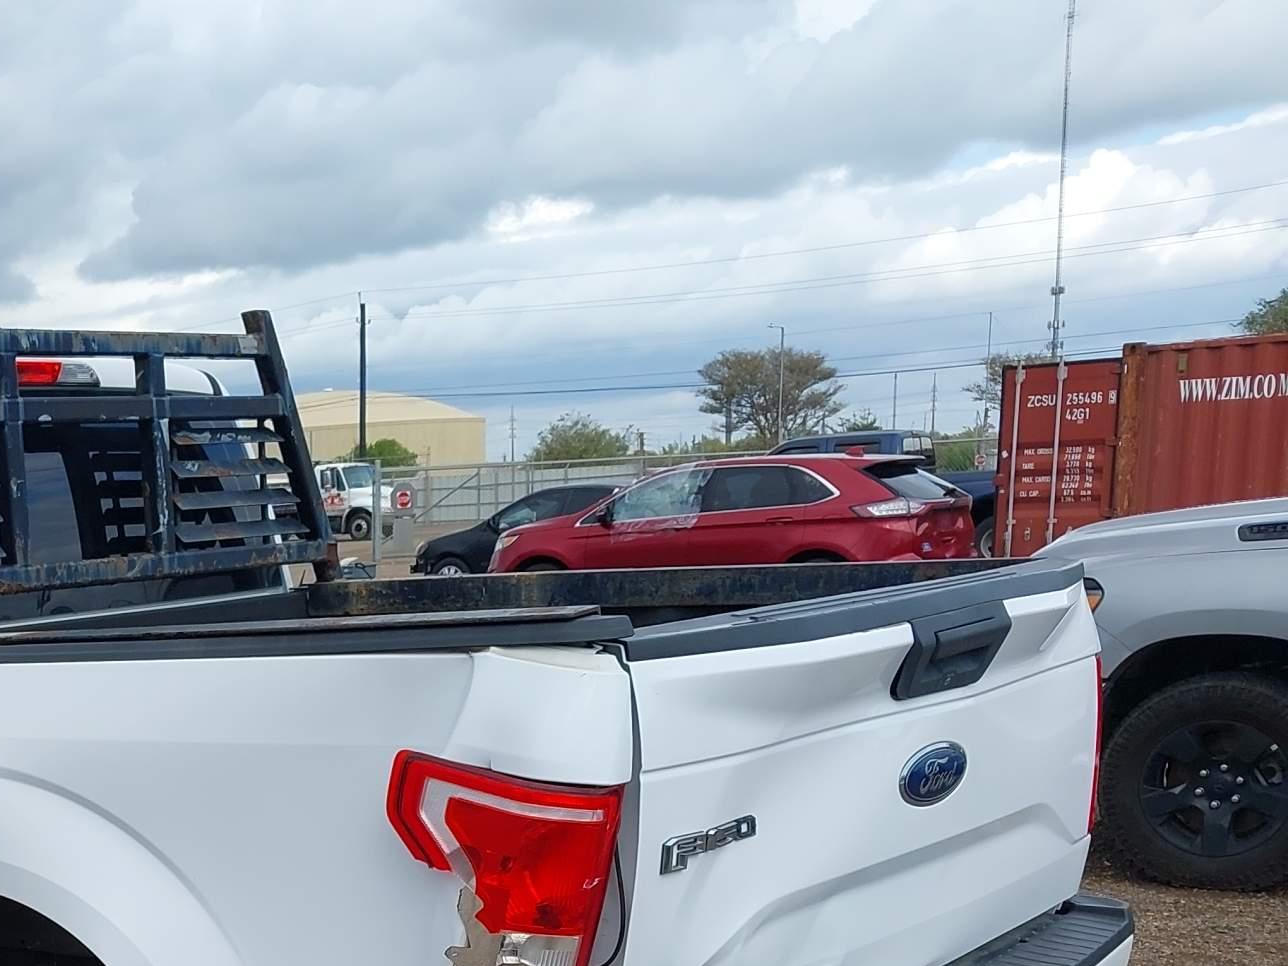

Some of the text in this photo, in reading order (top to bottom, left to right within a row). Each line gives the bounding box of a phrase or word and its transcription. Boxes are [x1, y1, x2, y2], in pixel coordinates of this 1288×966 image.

[1027, 394, 1056, 408] ZCSU
[1066, 391, 1103, 406] 255496
[1065, 407, 1090, 421] 42G1
[919, 756, 959, 795] Ford
